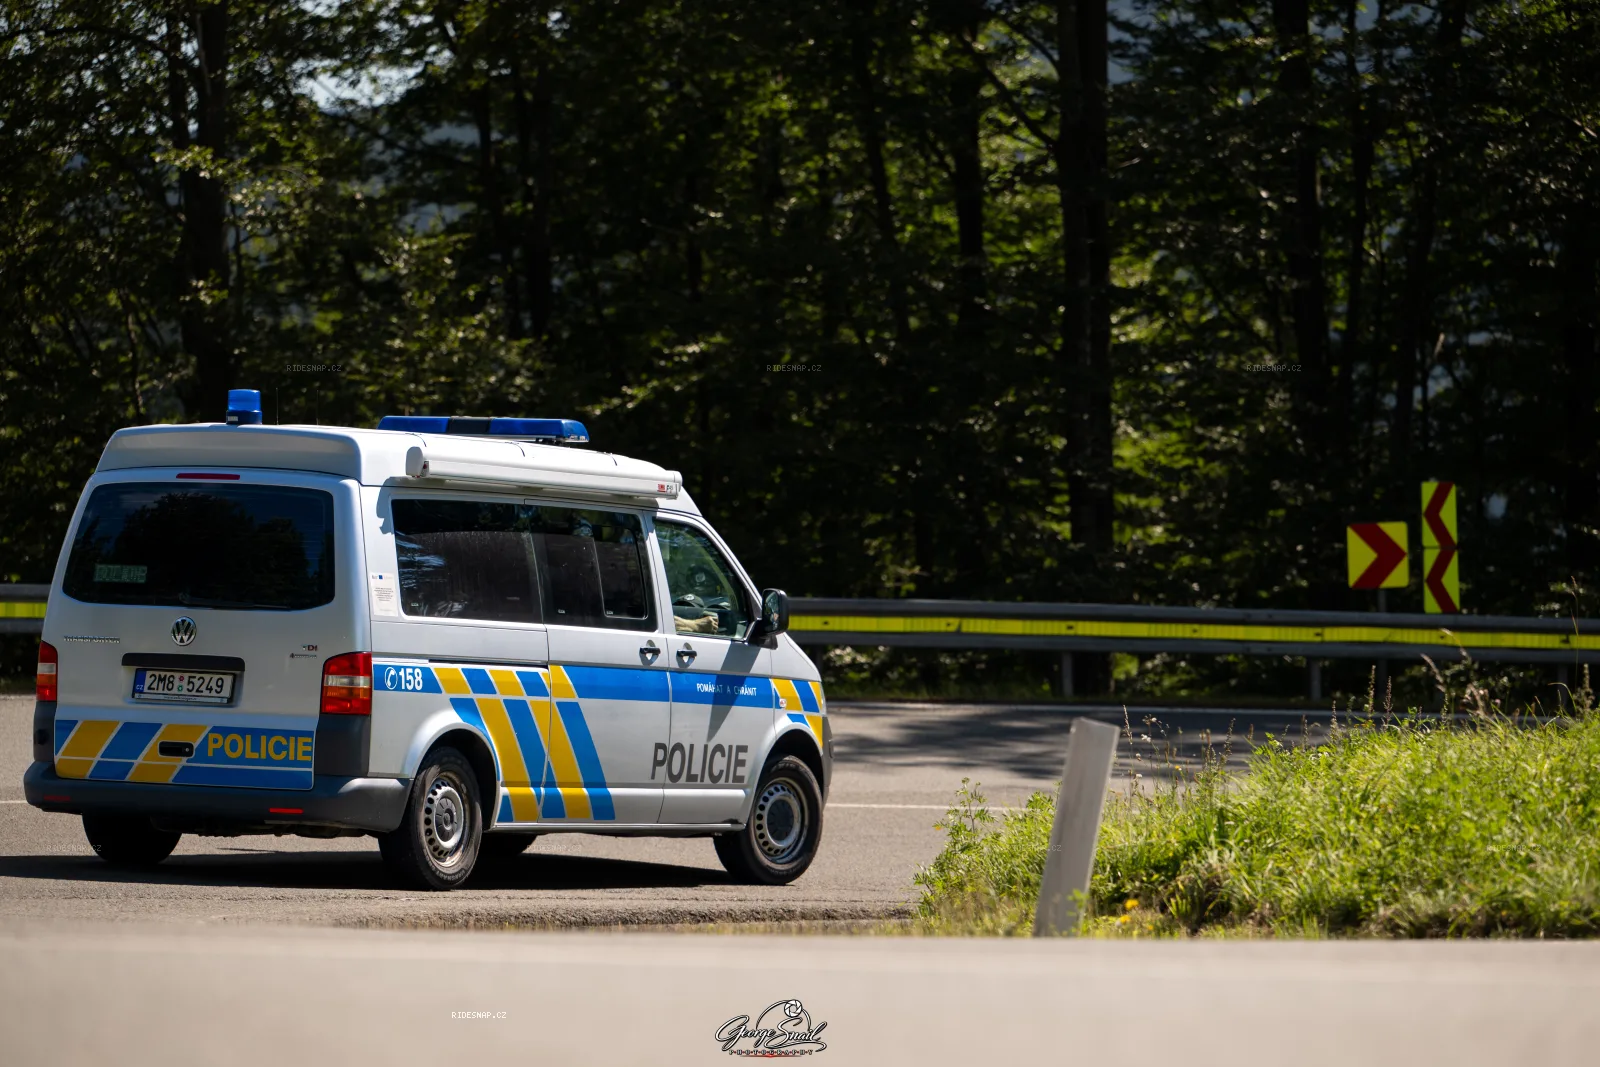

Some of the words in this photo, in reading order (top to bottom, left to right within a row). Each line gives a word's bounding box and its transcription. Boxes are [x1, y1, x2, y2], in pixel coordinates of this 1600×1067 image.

[147, 673, 175, 692] 2M8
[186, 675, 224, 695] 5249
[398, 667, 423, 691] 158
[696, 681, 723, 694] POMÁHAT
[726, 685, 732, 694] A
[733, 684, 757, 697] CHRÁNIT
[207, 732, 312, 762] POLICIE
[650, 741, 749, 785] POLICIE
